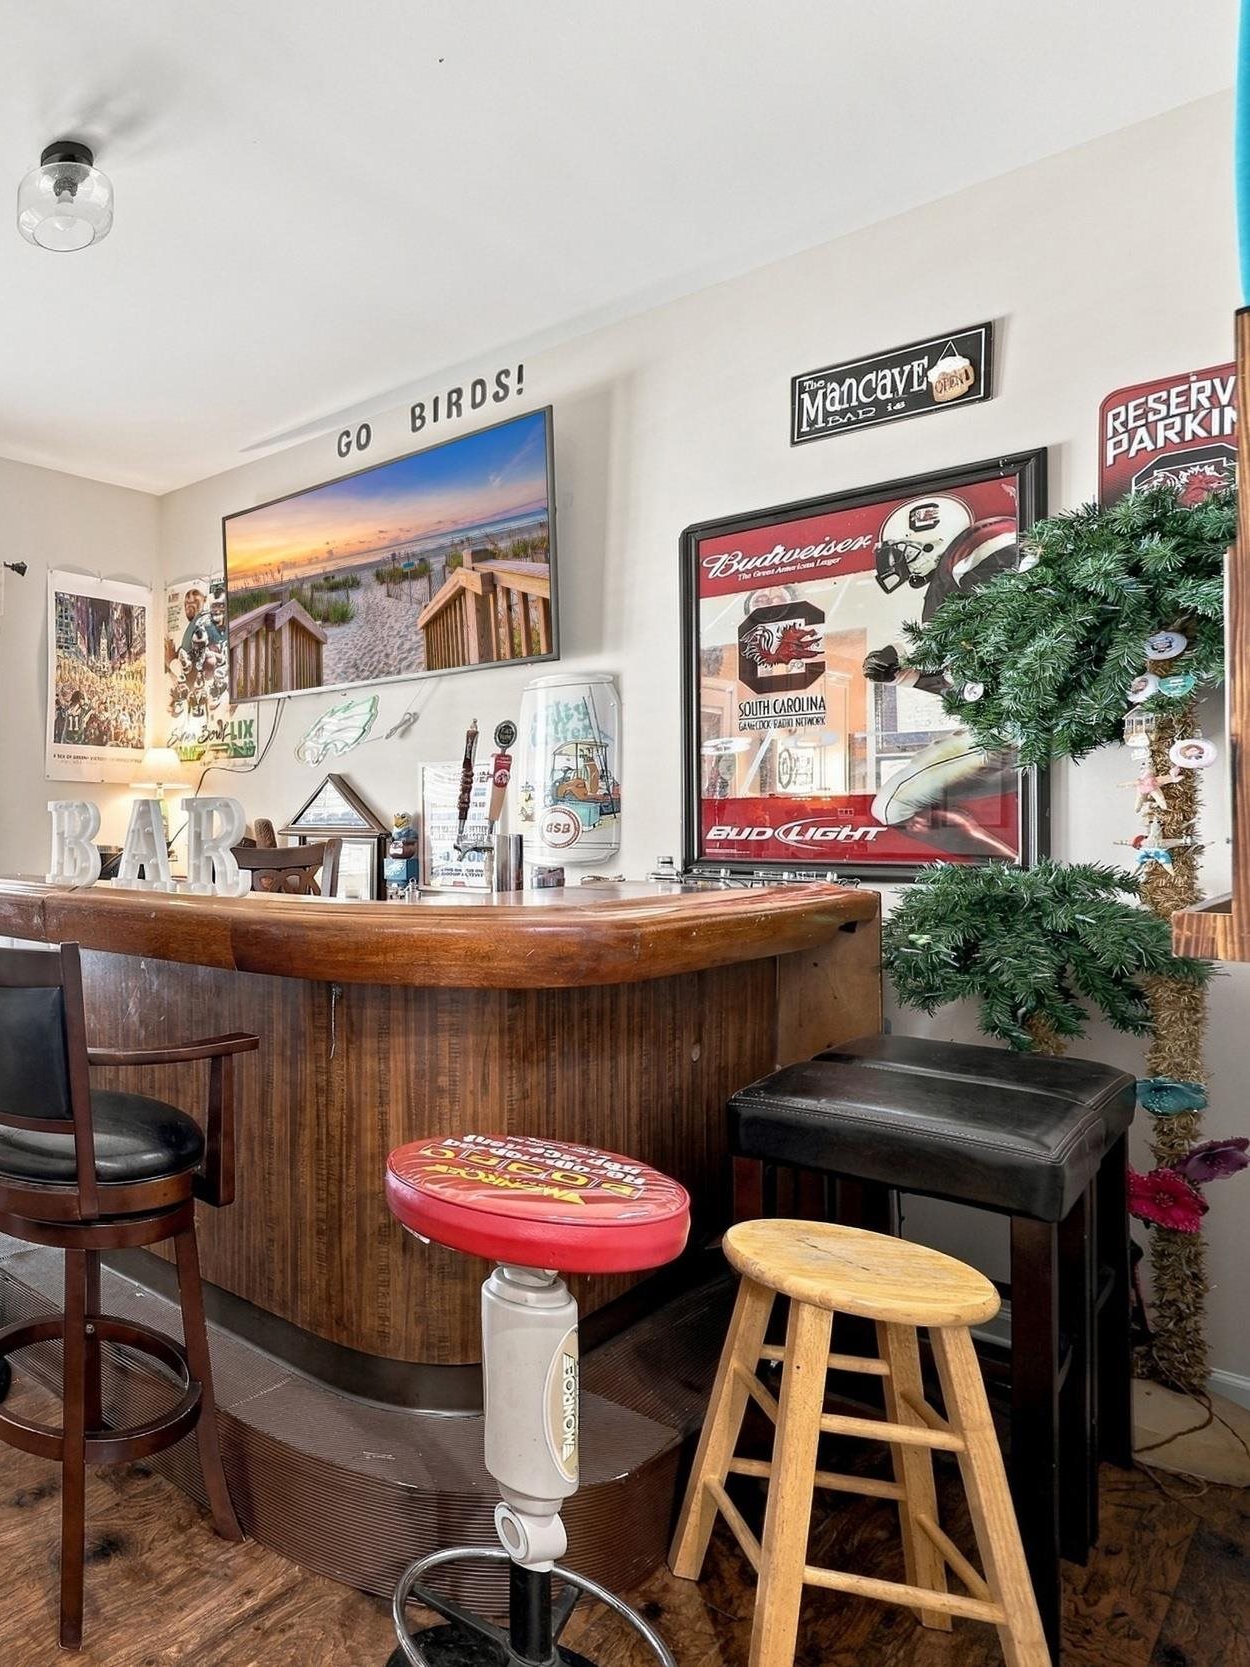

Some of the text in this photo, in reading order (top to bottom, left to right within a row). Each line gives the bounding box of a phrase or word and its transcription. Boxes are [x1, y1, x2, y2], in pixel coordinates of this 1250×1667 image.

[803, 380, 825, 391] The
[337, 364, 524, 458] GO BIRDS!
[827, 407, 876, 427] BAR
[1107, 375, 1237, 438] RESERV
[1106, 406, 1238, 467] PARKIN
[702, 534, 873, 579] Budweiser
[737, 557, 842, 582] The Great American Lager
[738, 695, 826, 718] SOUTH CAROLINA
[230, 719, 254, 740] LIX
[546, 822, 571, 833] GSB
[706, 825, 888, 841] BUD LIGHT
[46, 797, 252, 898] BAR
[562, 1366, 577, 1445] MONROE
